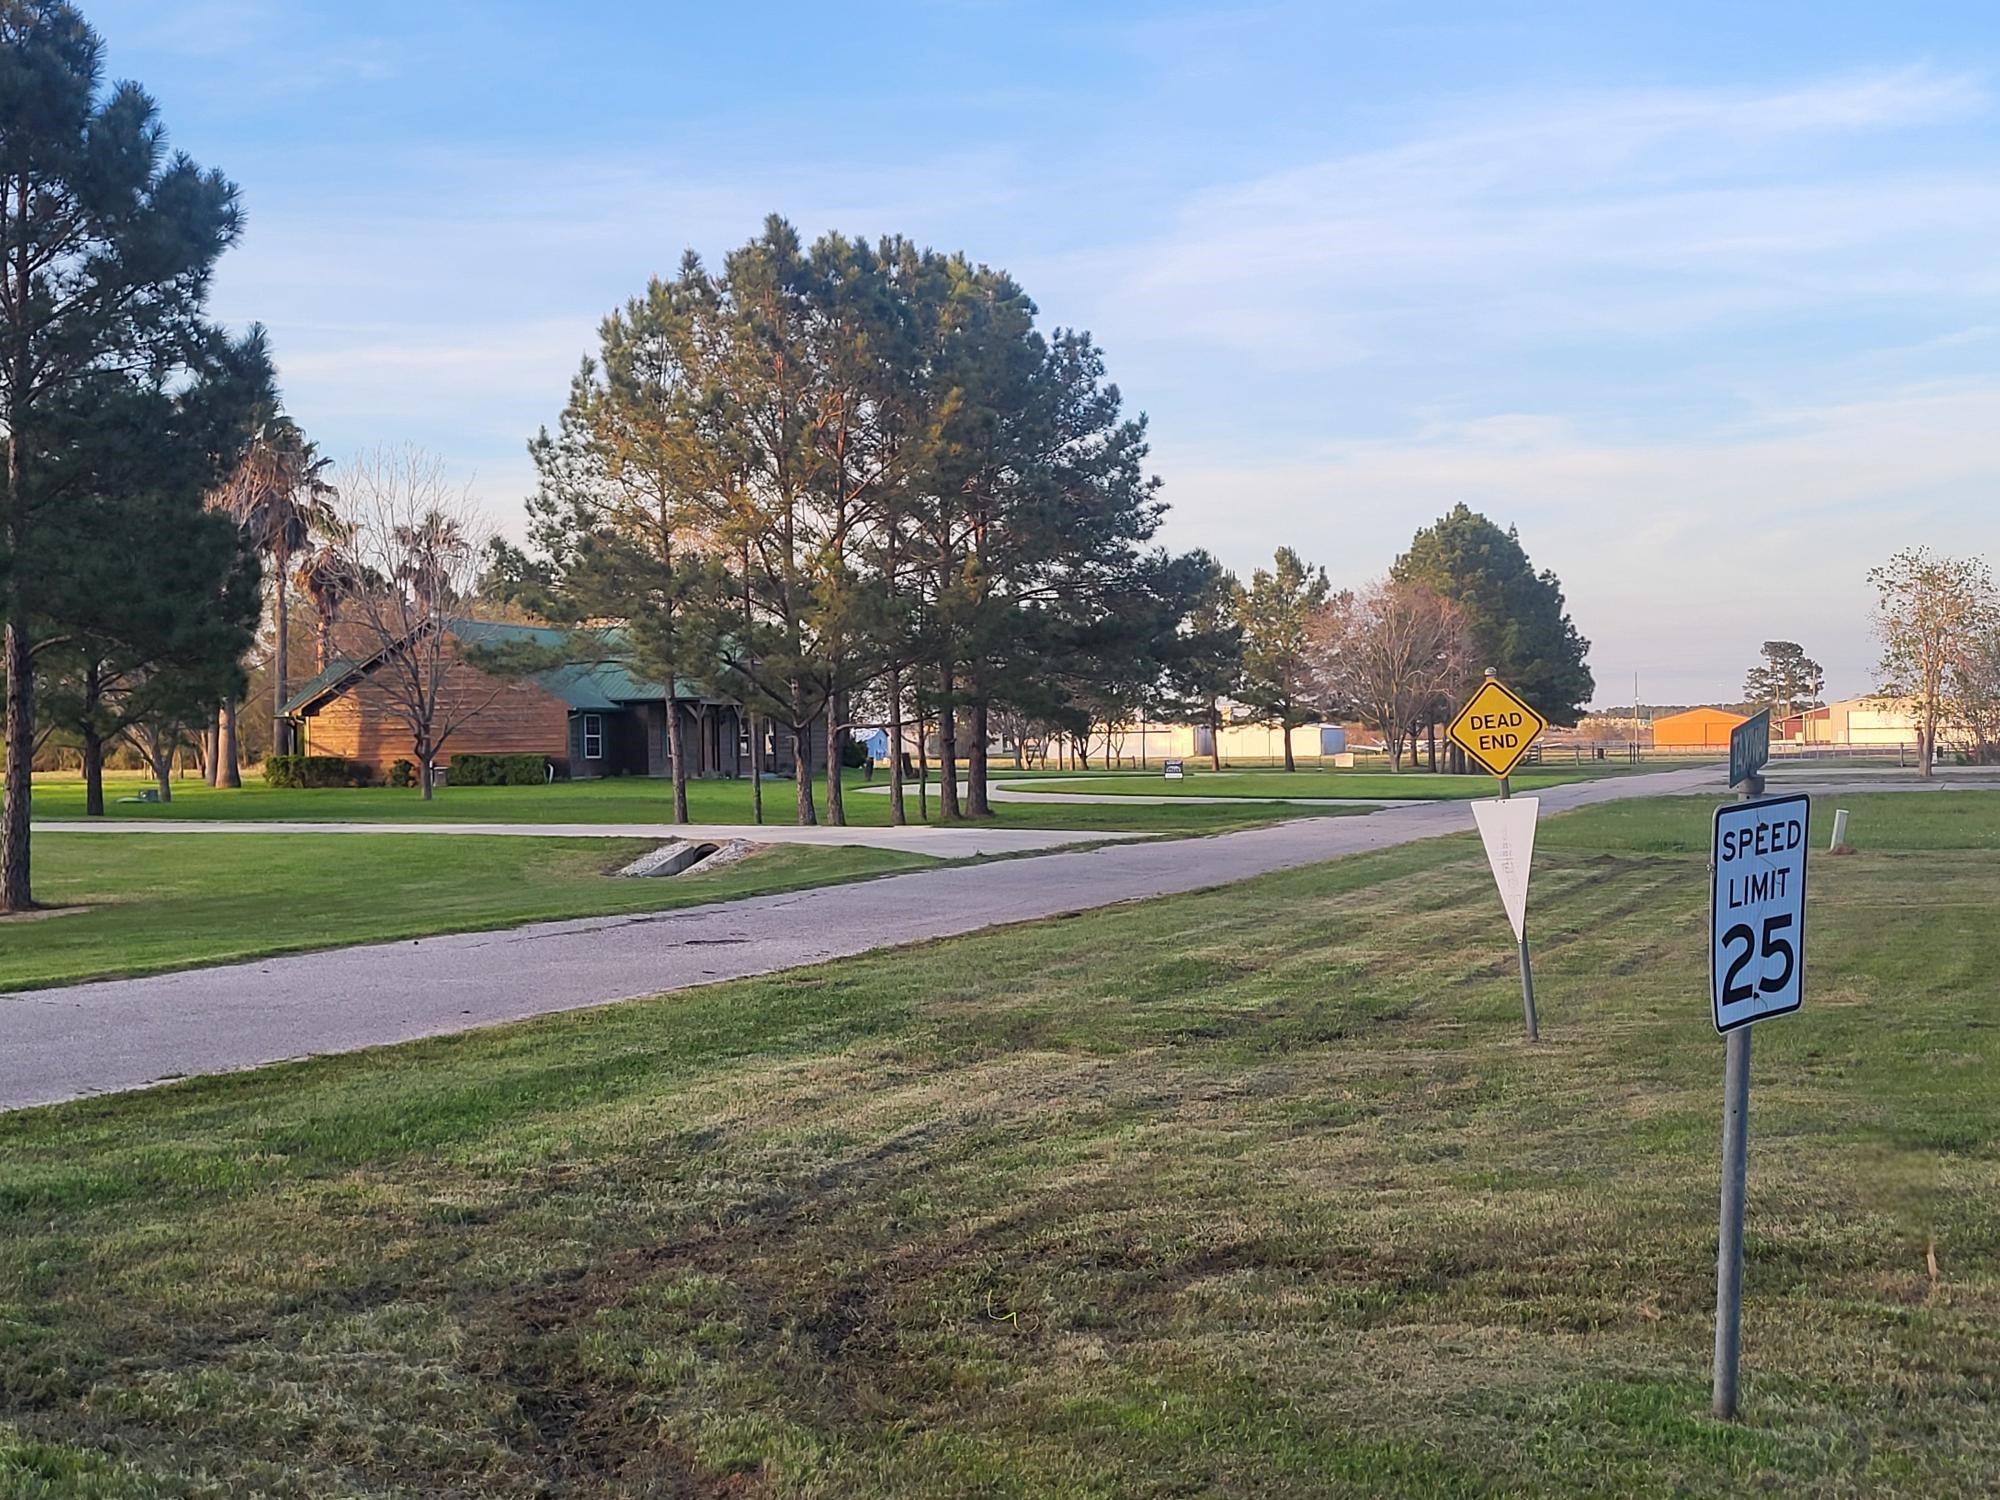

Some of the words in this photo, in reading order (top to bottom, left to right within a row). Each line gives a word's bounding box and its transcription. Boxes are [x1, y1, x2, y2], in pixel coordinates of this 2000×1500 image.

[1470, 712, 1522, 730] DEAD
[1479, 733, 1518, 750] END
[1722, 819, 1801, 862] SPEED
[1729, 867, 1790, 909] LIMIT
[1721, 913, 1794, 1006] 25
